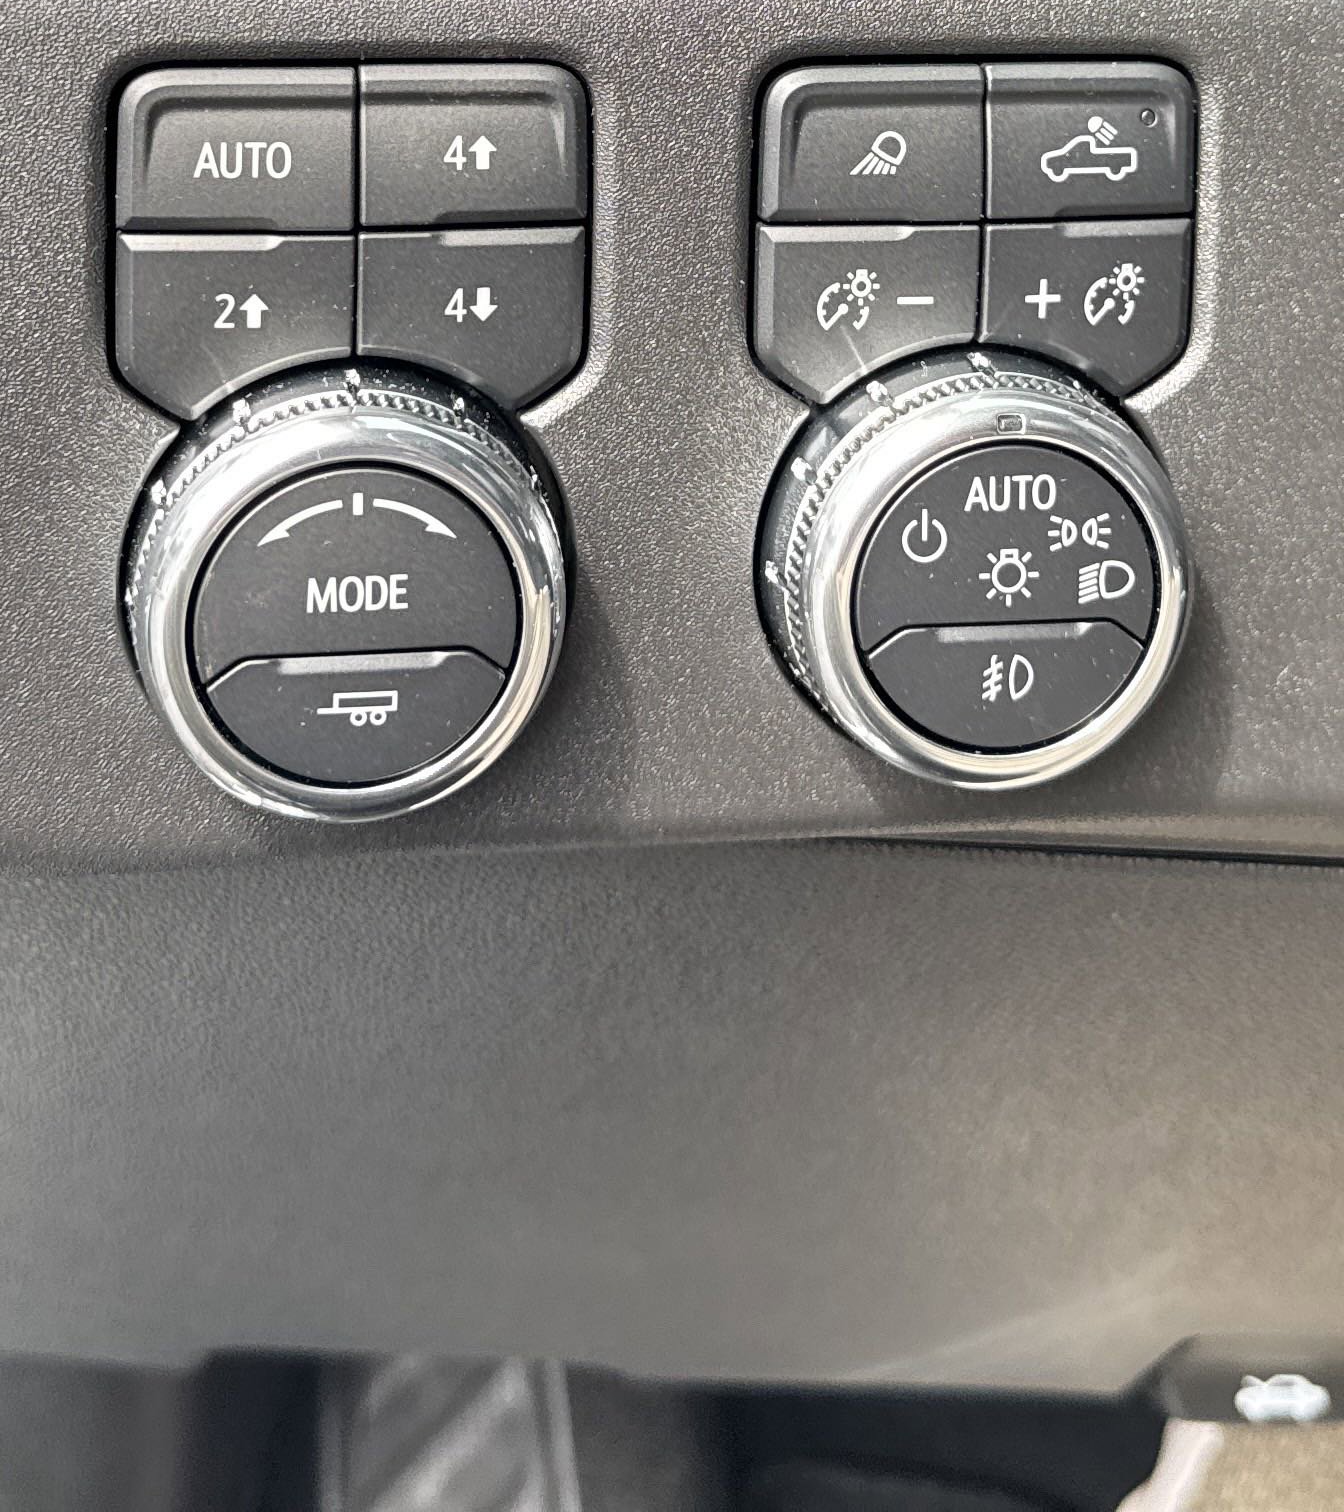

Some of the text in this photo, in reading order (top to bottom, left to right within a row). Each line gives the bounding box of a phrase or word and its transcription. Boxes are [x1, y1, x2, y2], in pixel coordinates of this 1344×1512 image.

[193, 141, 293, 179] AUTO
[443, 134, 467, 171] 4
[213, 293, 236, 329] 2
[444, 287, 467, 323] 4
[963, 473, 1057, 512] AUTO
[306, 573, 409, 614] MODE
